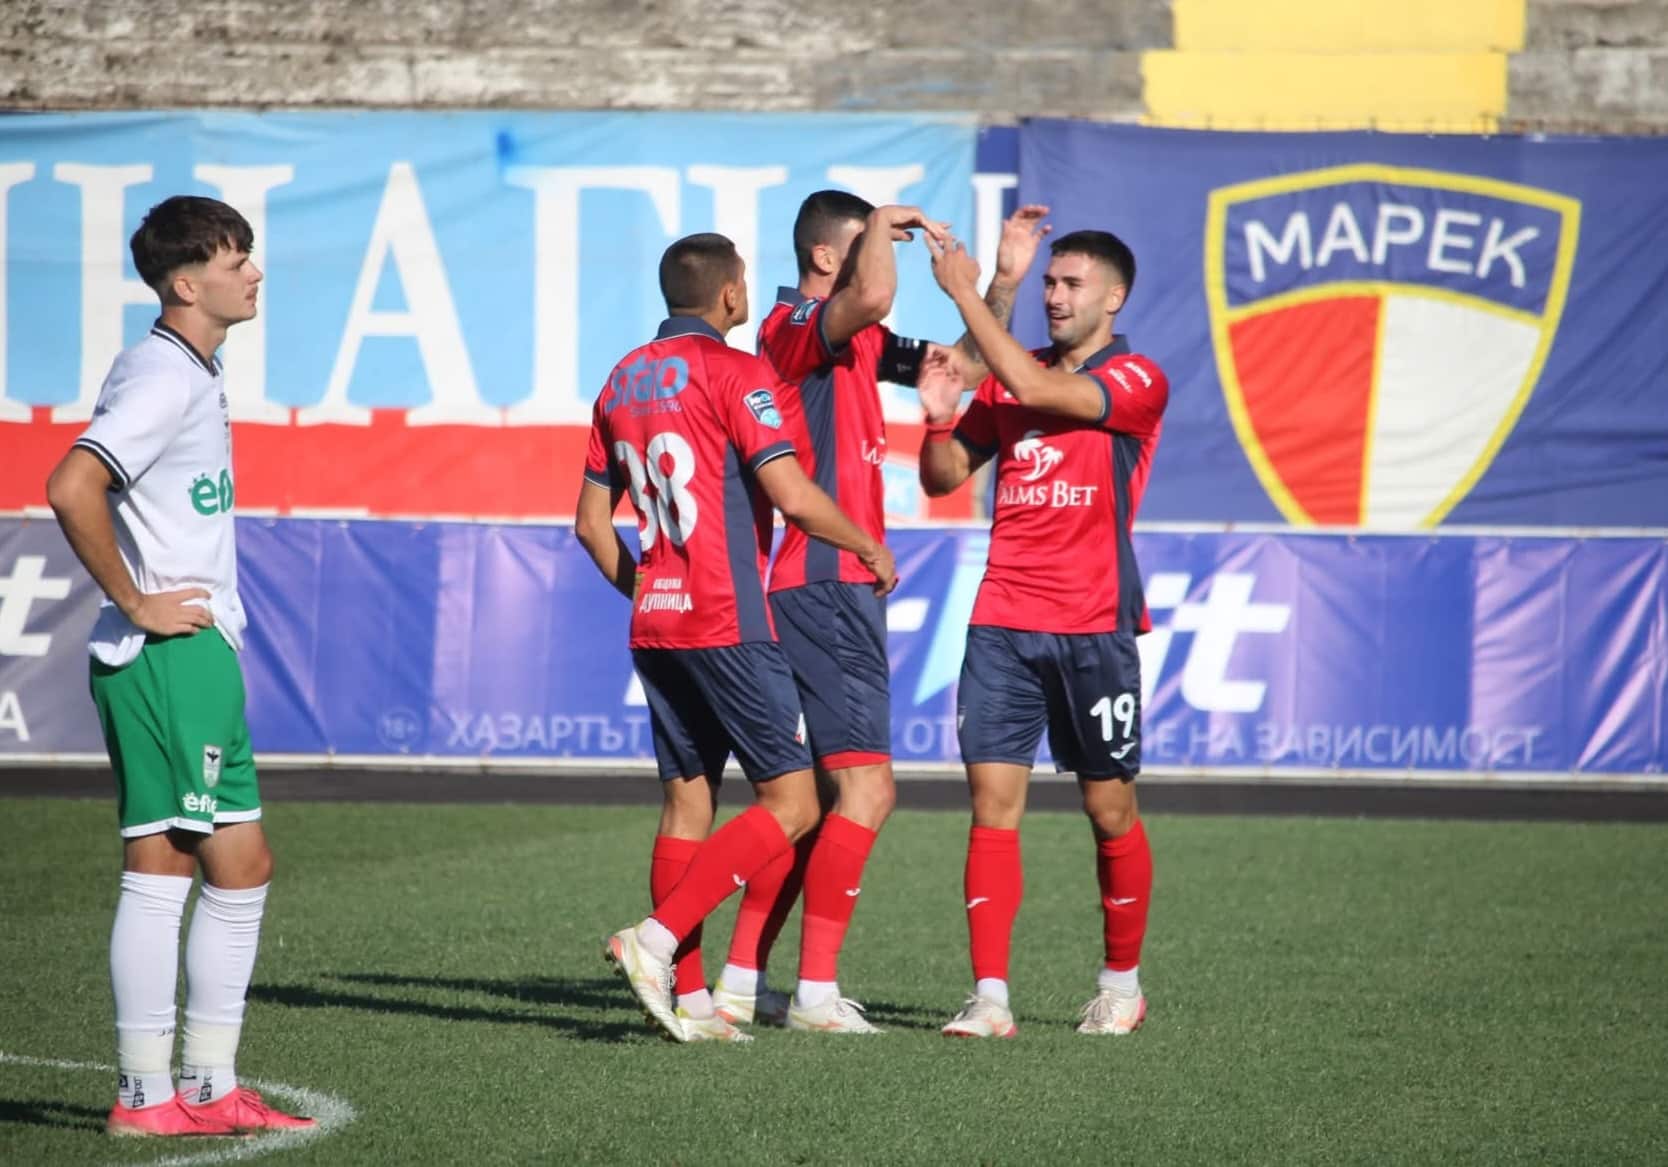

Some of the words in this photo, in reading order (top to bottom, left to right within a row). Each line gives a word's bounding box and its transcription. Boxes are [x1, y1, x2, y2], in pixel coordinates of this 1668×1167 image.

[1244, 201, 1540, 289] МАРЕК
[998, 483, 1048, 506] ALMS
[639, 592, 694, 614] ДУПНИЦА
[447, 709, 649, 751] ХАЗАРТЪТ
[1189, 723, 1245, 759] НА
[1256, 724, 1543, 765] ЗАВИСИМОСТ
[1089, 693, 1136, 741] 19
